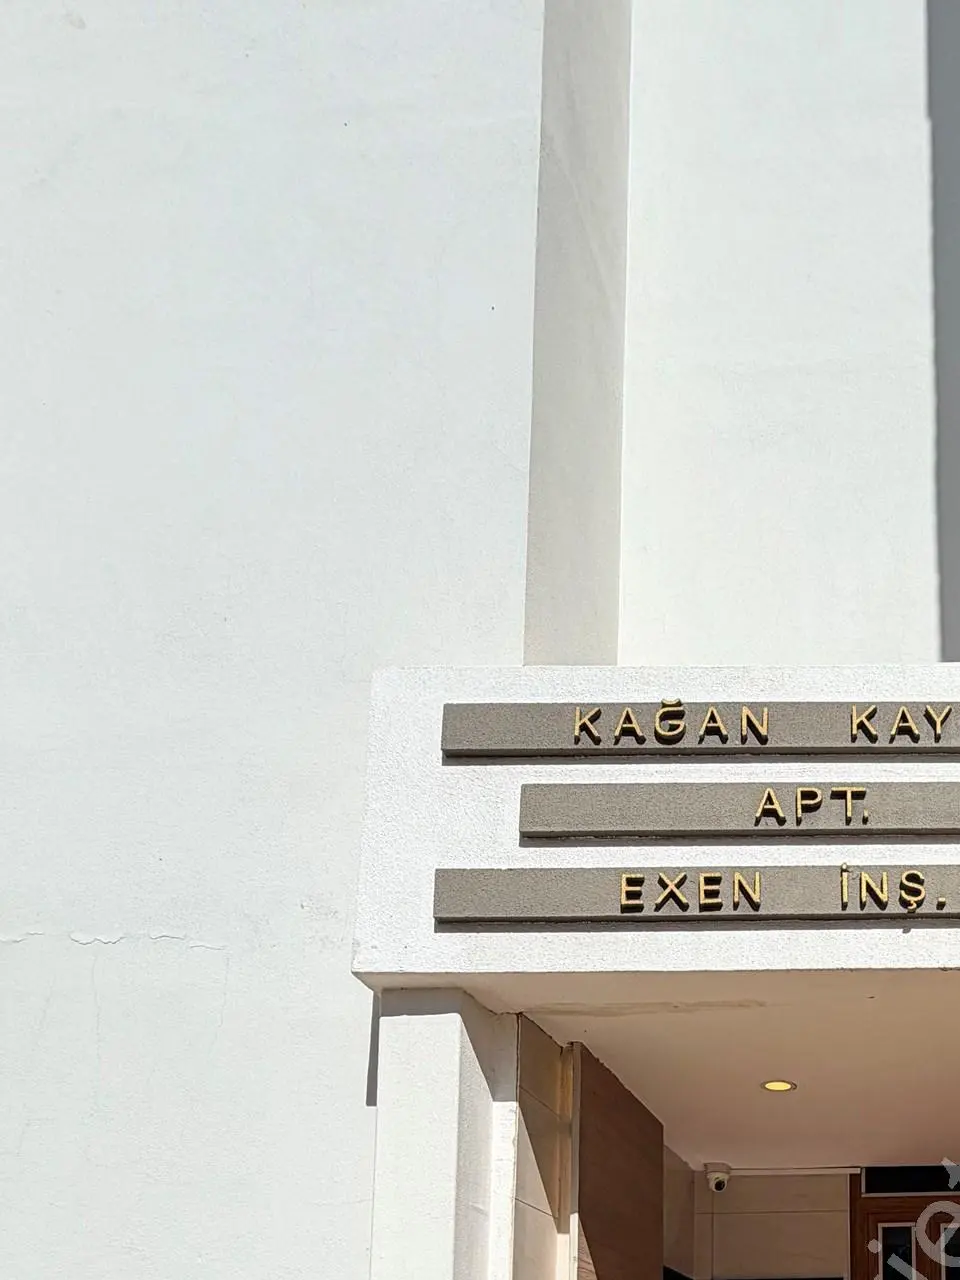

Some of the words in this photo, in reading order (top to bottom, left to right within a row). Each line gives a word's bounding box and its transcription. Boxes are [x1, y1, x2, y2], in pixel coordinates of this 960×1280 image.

[574, 698, 769, 744] KAĞAN
[754, 786, 868, 826] APT.
[620, 871, 761, 913] EXEN
[840, 863, 946, 913] İNŞ.
